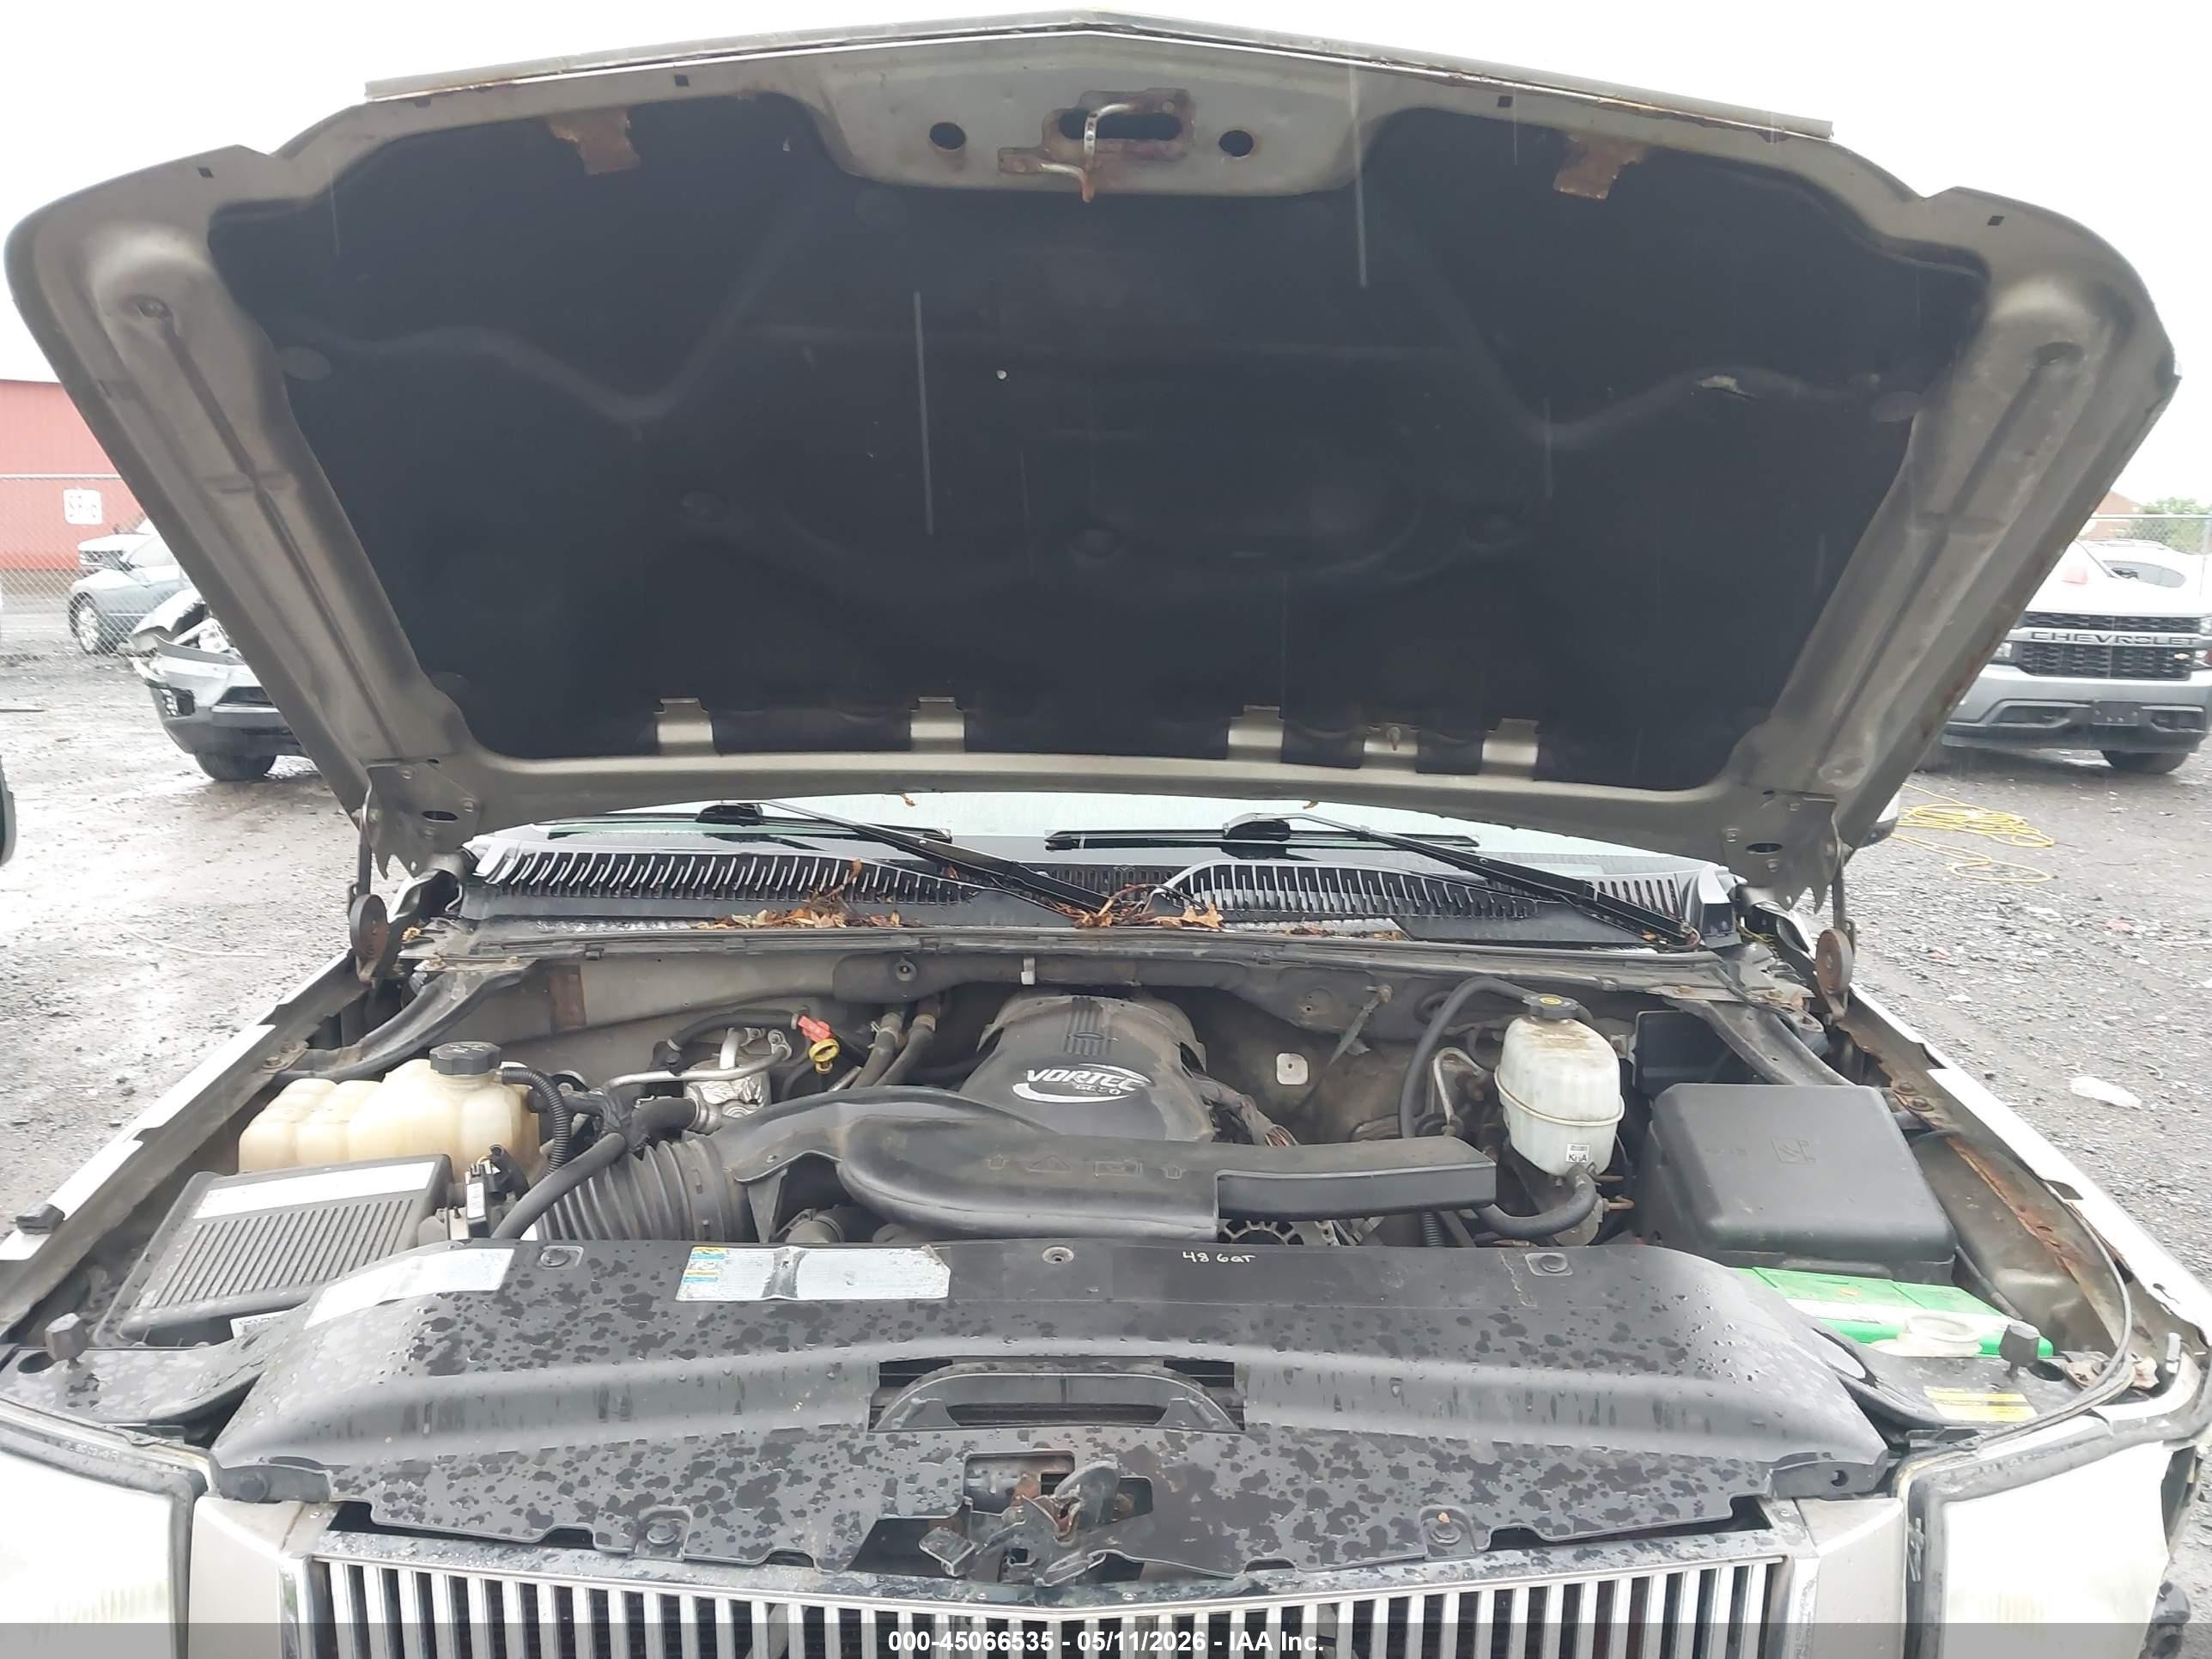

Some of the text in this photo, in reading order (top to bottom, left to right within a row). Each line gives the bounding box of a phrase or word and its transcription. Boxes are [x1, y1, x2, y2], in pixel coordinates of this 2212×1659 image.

[2031, 631, 2198, 646] CHEVROLET
[1027, 1068, 1147, 1091] VORTEC
[1182, 1251, 1210, 1263] 48
